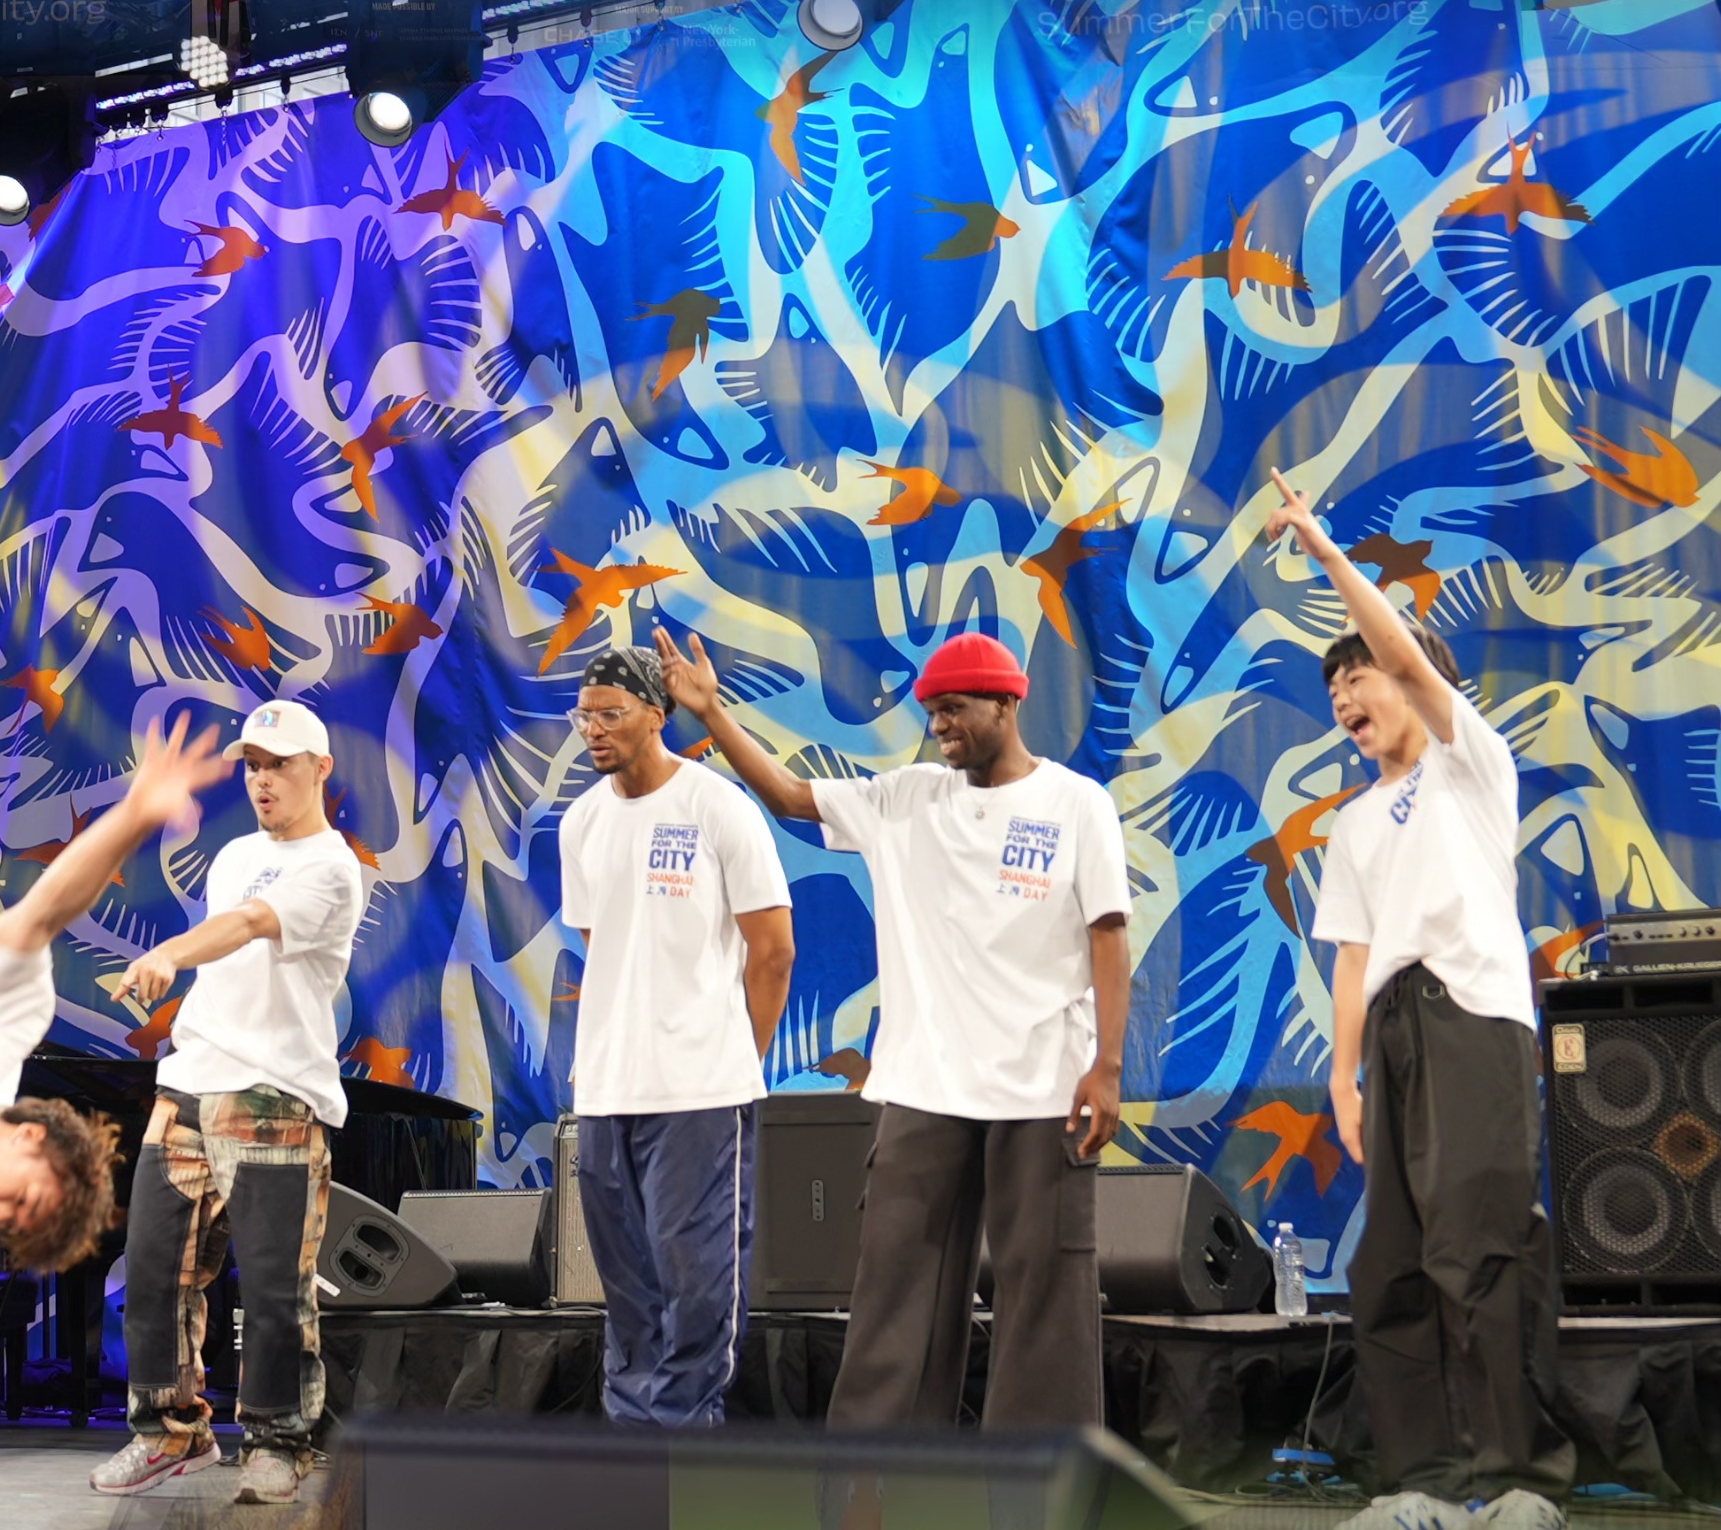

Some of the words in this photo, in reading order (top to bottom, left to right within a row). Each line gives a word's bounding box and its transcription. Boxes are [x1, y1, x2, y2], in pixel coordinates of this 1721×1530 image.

[372, 2, 392, 11] MADE
[426, 2, 436, 11] BY
[682, 36, 757, 49] Presbyterian
[653, 826, 699, 841] SUMMER
[1008, 819, 1061, 841] SUMMER
[651, 839, 672, 848] FOR
[676, 840, 696, 850] THE
[1006, 832, 1030, 844] FOR
[1035, 837, 1058, 850] THE
[648, 848, 696, 872] CITY
[1001, 844, 1055, 873] CITY
[646, 872, 695, 886] SHANGHAI
[669, 886, 692, 898] DAY
[1023, 887, 1049, 902] DAY
